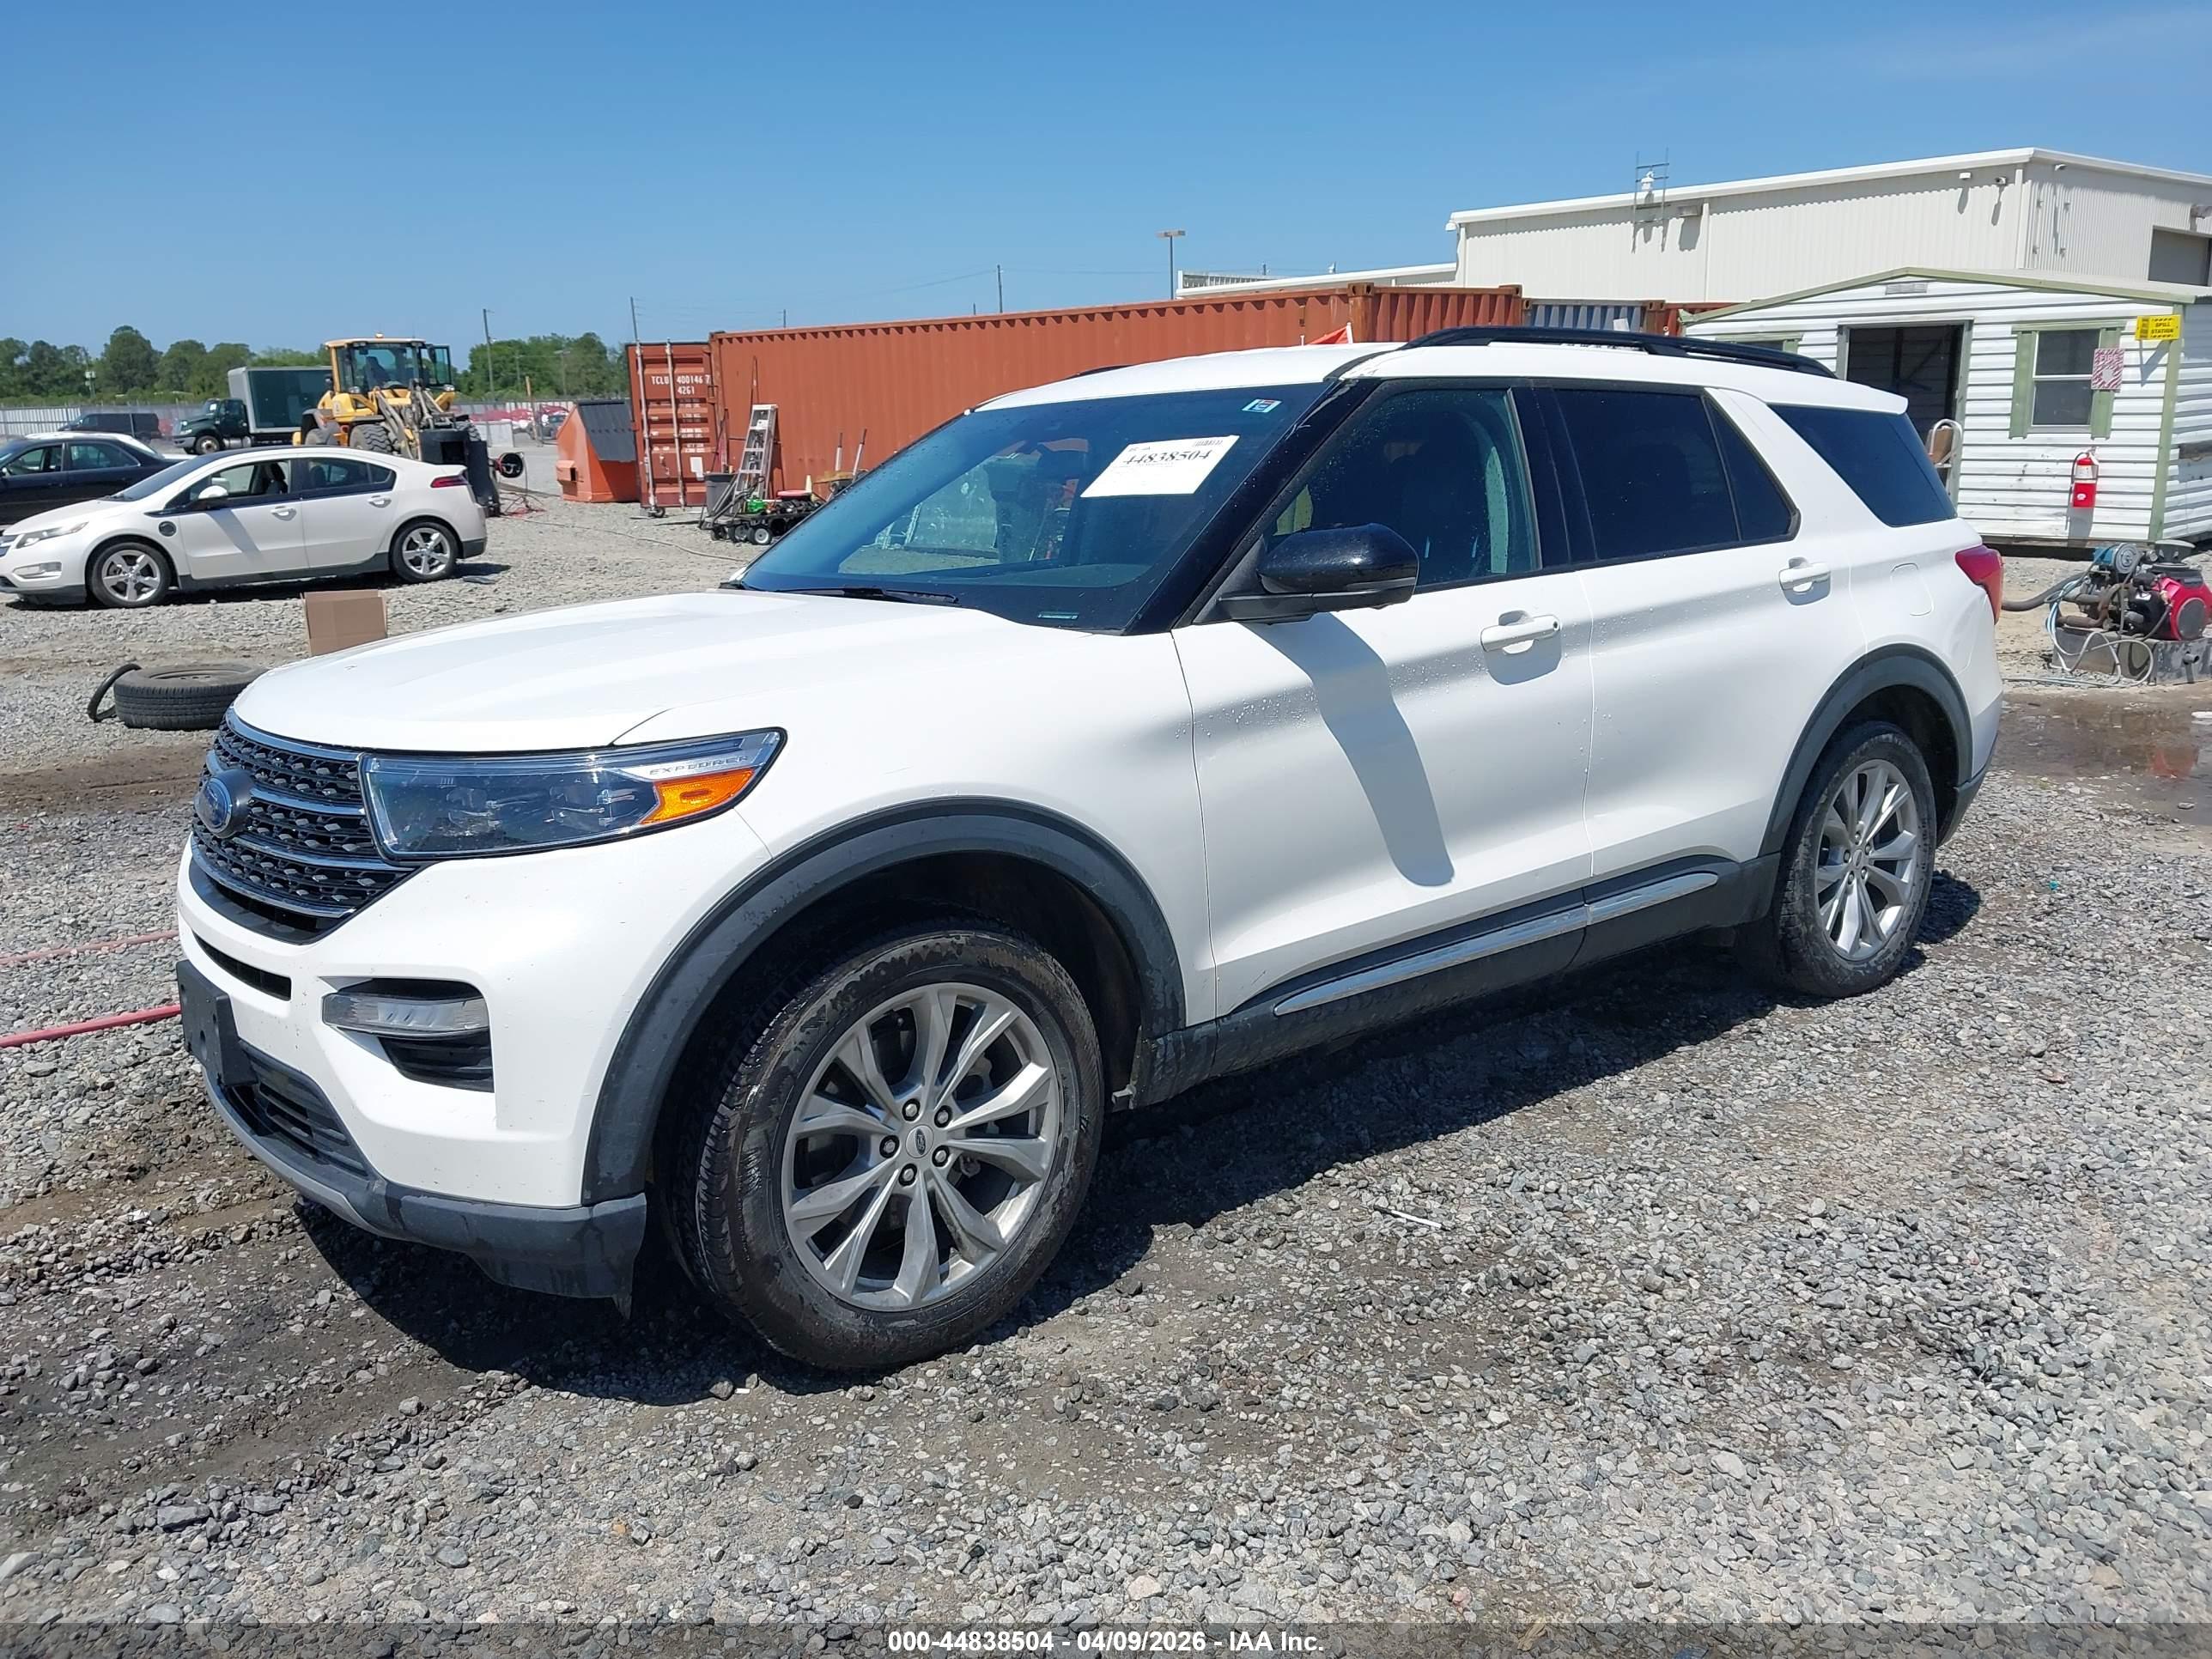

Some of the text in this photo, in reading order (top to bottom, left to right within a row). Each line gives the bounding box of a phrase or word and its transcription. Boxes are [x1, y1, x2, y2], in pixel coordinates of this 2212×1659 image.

[651, 374, 711, 386] TCLU 400146 7
[677, 386, 695, 395] 4261
[1122, 448, 1212, 465] 44838504
[649, 756, 749, 775] EXPLORER
